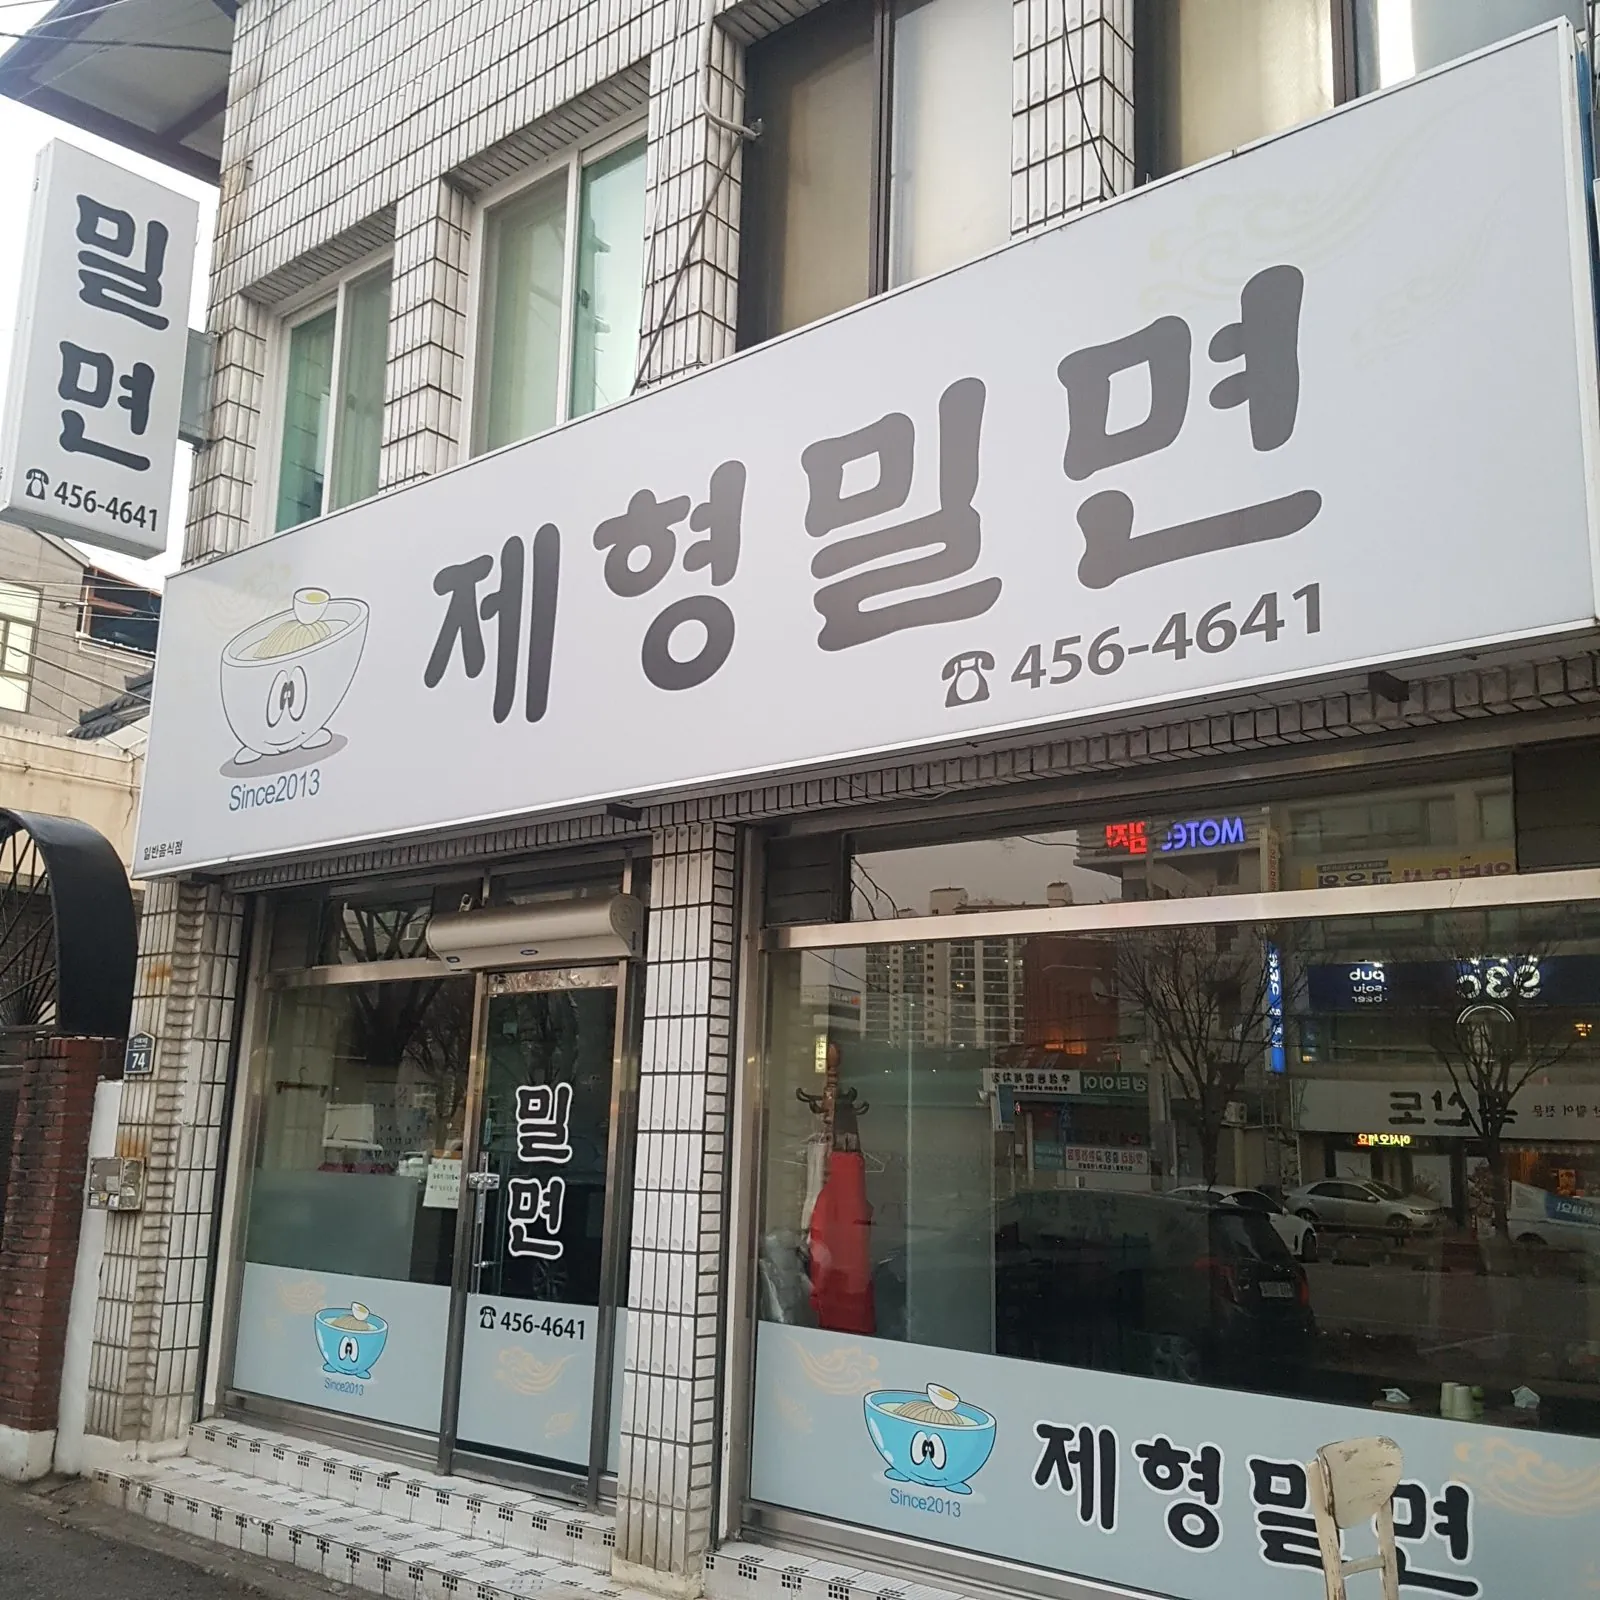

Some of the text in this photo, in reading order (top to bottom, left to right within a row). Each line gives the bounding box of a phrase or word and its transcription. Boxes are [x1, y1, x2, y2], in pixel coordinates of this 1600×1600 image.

[59, 195, 169, 471] 밀면
[54, 481, 157, 532] 456-4641
[424, 265, 1322, 723] 제형밀면
[1011, 583, 1320, 688] 456-4641
[229, 769, 319, 811] Since2013
[144, 841, 183, 860] 일반음식점
[130, 1049, 146, 1069] 74
[508, 1082, 573, 1260] 밀면
[500, 1311, 585, 1341] 456-4641
[324, 1377, 365, 1397] Since2013
[889, 1487, 962, 1518] Since2013
